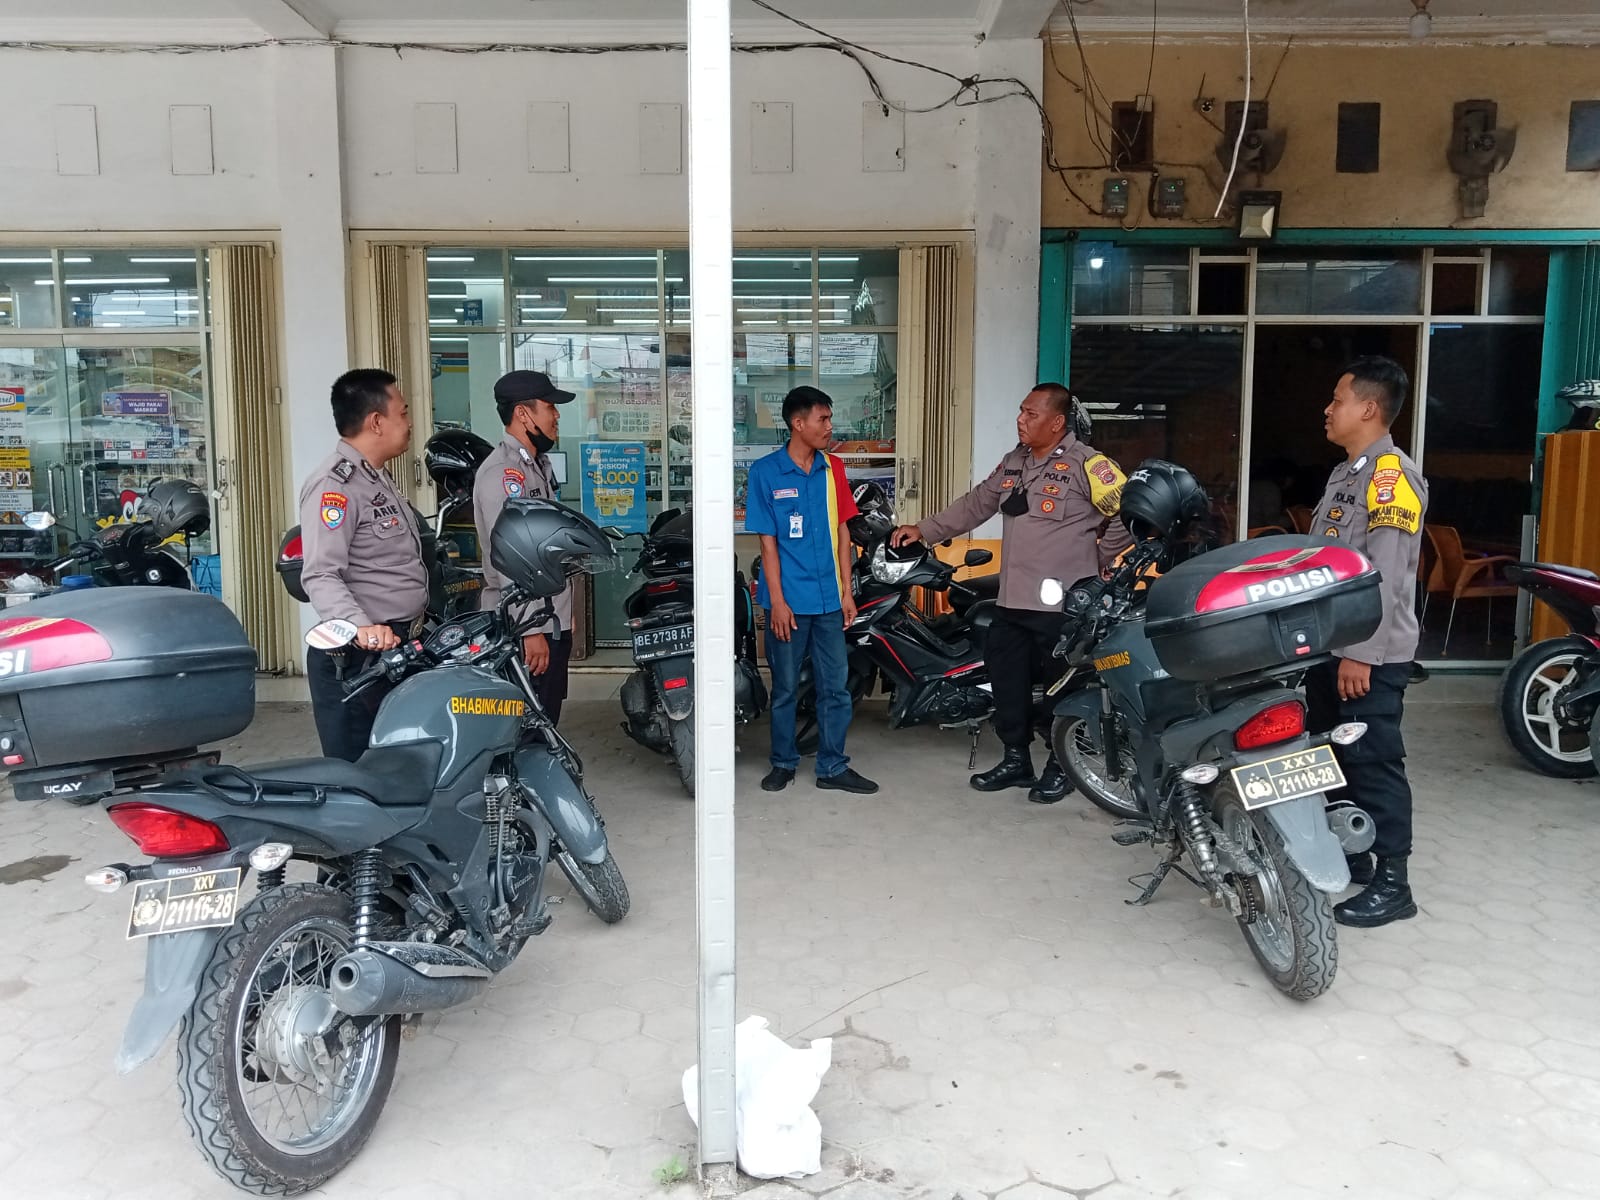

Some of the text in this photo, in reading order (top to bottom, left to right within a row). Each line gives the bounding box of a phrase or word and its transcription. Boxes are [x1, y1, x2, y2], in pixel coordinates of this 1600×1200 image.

[592, 470, 639, 485] 5.000
[1043, 472, 1071, 484] POLRI
[373, 504, 399, 520] ARIE
[1248, 567, 1335, 604] POLISI
[637, 633, 651, 646] BE
[652, 629, 678, 644] 2738
[1281, 753, 1316, 770] XXV
[167, 865, 203, 876] HONDA
[193, 874, 217, 891] XXV
